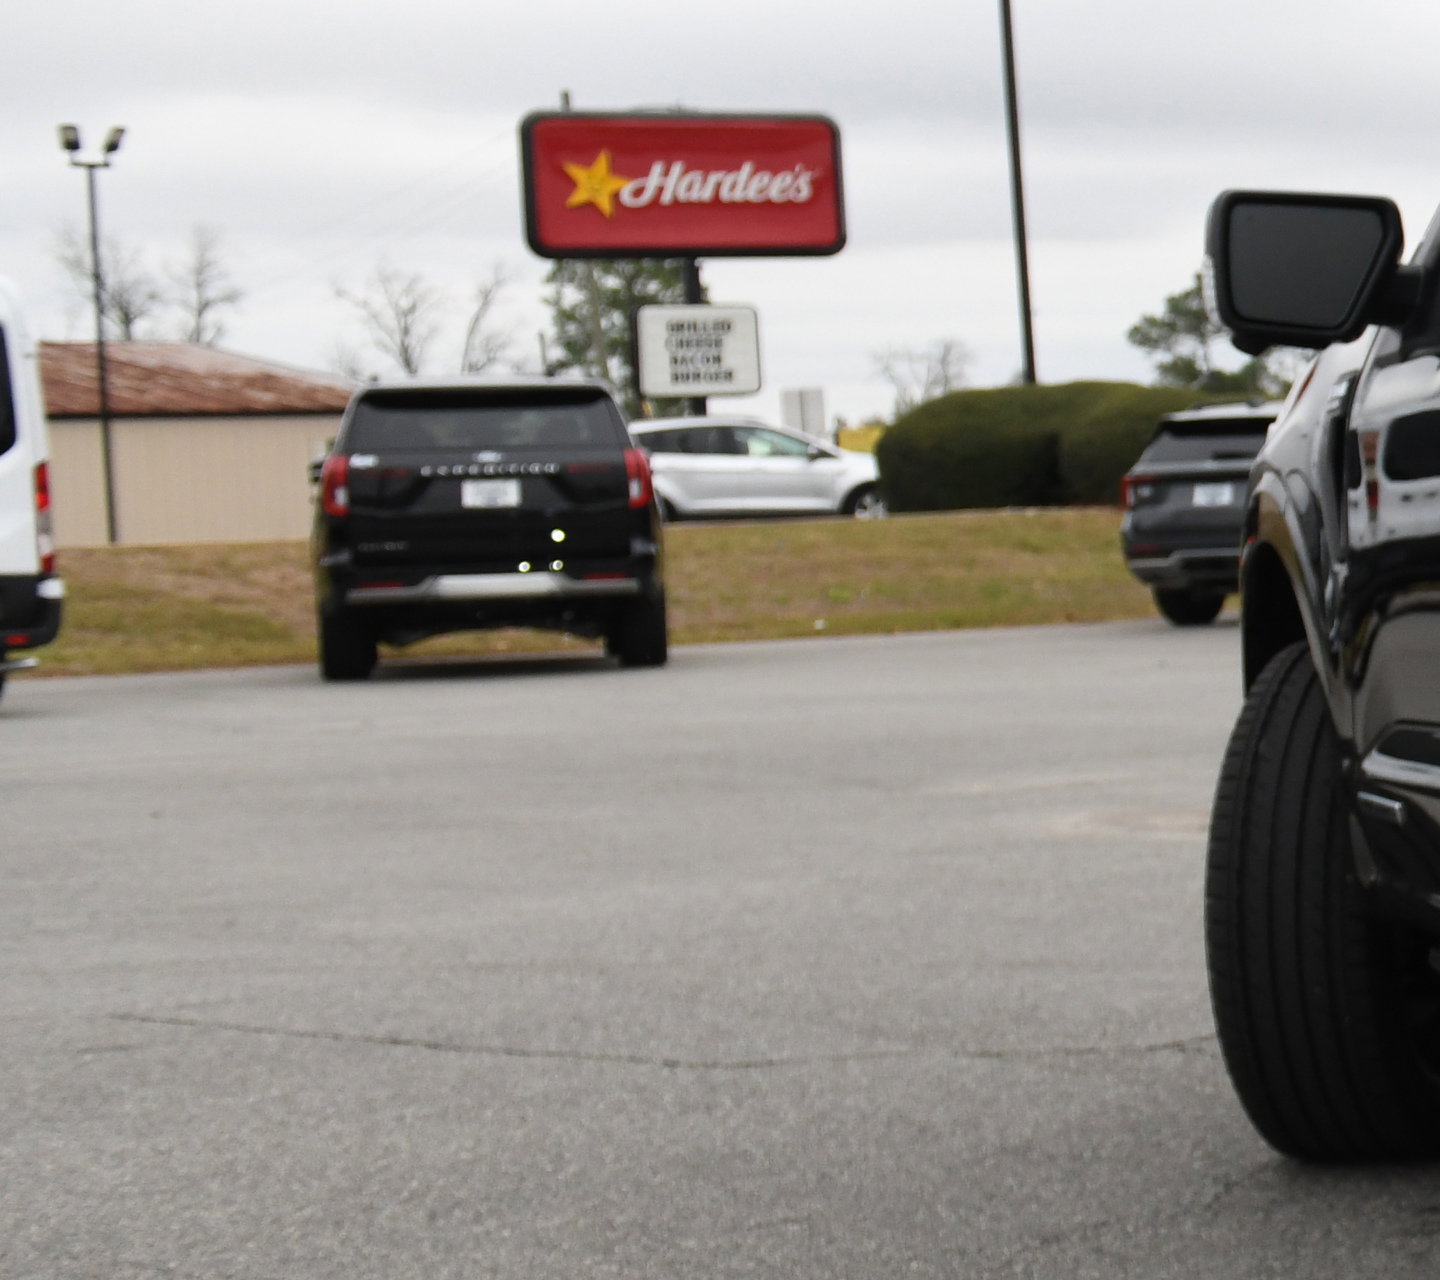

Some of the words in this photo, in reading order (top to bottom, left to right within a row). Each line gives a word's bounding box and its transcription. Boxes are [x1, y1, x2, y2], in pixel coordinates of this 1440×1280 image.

[618, 159, 814, 208] Hardee's
[670, 353, 722, 367] BACON
[670, 370, 734, 384] BURGER
